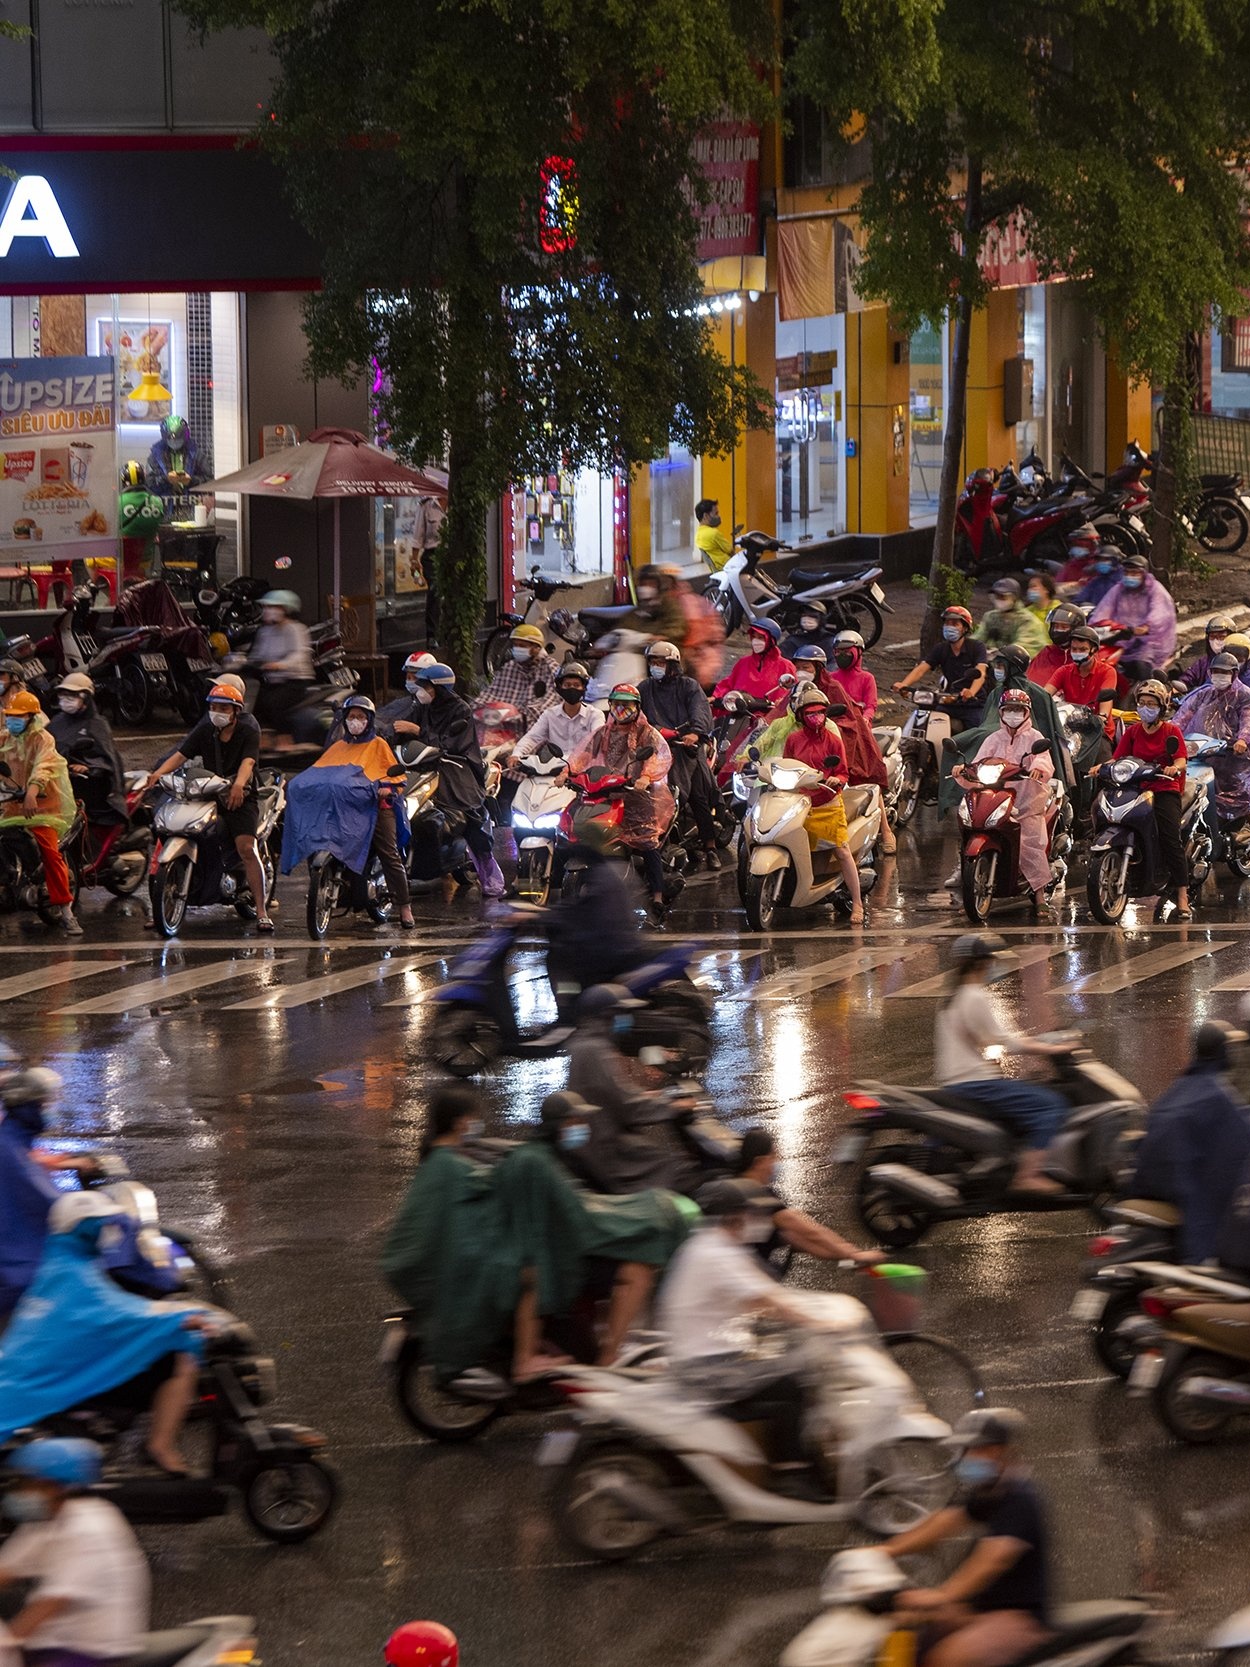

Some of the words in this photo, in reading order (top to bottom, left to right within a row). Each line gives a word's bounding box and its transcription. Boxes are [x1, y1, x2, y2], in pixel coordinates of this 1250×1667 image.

[0, 373, 114, 412] UPSIZE
[2, 411, 44, 436] SIÊU
[48, 409, 74, 431] ƯU
[78, 402, 110, 428] ĐÃI
